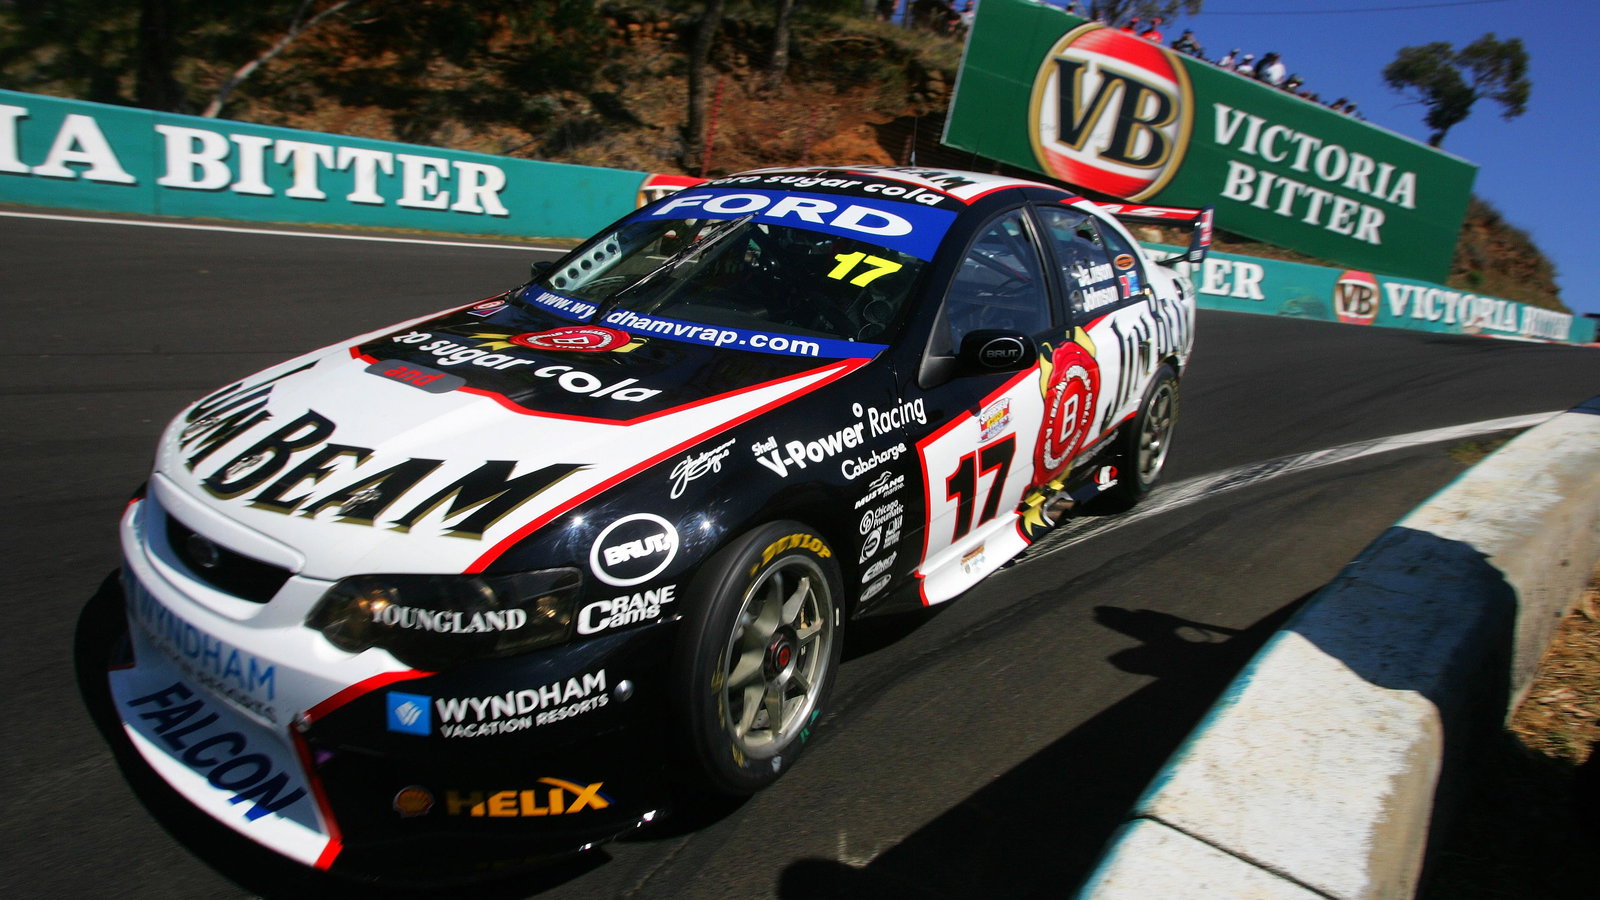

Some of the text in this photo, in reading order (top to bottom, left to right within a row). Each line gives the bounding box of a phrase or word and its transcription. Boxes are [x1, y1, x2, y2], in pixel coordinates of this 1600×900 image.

[1054, 57, 1178, 169] VB
[155, 124, 510, 217] BITTER
[1213, 103, 1417, 210] VICTORIA
[651, 193, 913, 237] FORD
[763, 175, 863, 190] sugar
[863, 183, 946, 206] cola
[1219, 160, 1387, 246] BITTER
[826, 251, 903, 288] 17
[1383, 282, 1518, 333] VICTORIA
[383, 363, 448, 387] and
[418, 339, 536, 371] sugar
[533, 364, 664, 404] cola
[751, 435, 778, 457] Shell
[756, 421, 868, 479] V-Power
[867, 397, 928, 438] Racing
[841, 442, 908, 481] Cabcharge
[198, 408, 602, 542] BEAM
[854, 474, 905, 510] MUSTANG
[945, 431, 1016, 544] 17
[874, 499, 898, 519] Chicago
[761, 533, 833, 567] DUNLOP
[435, 669, 607, 724] WYNDHAM
[440, 693, 610, 739] VACATION RESORTS
[127, 681, 307, 823] FALCON
